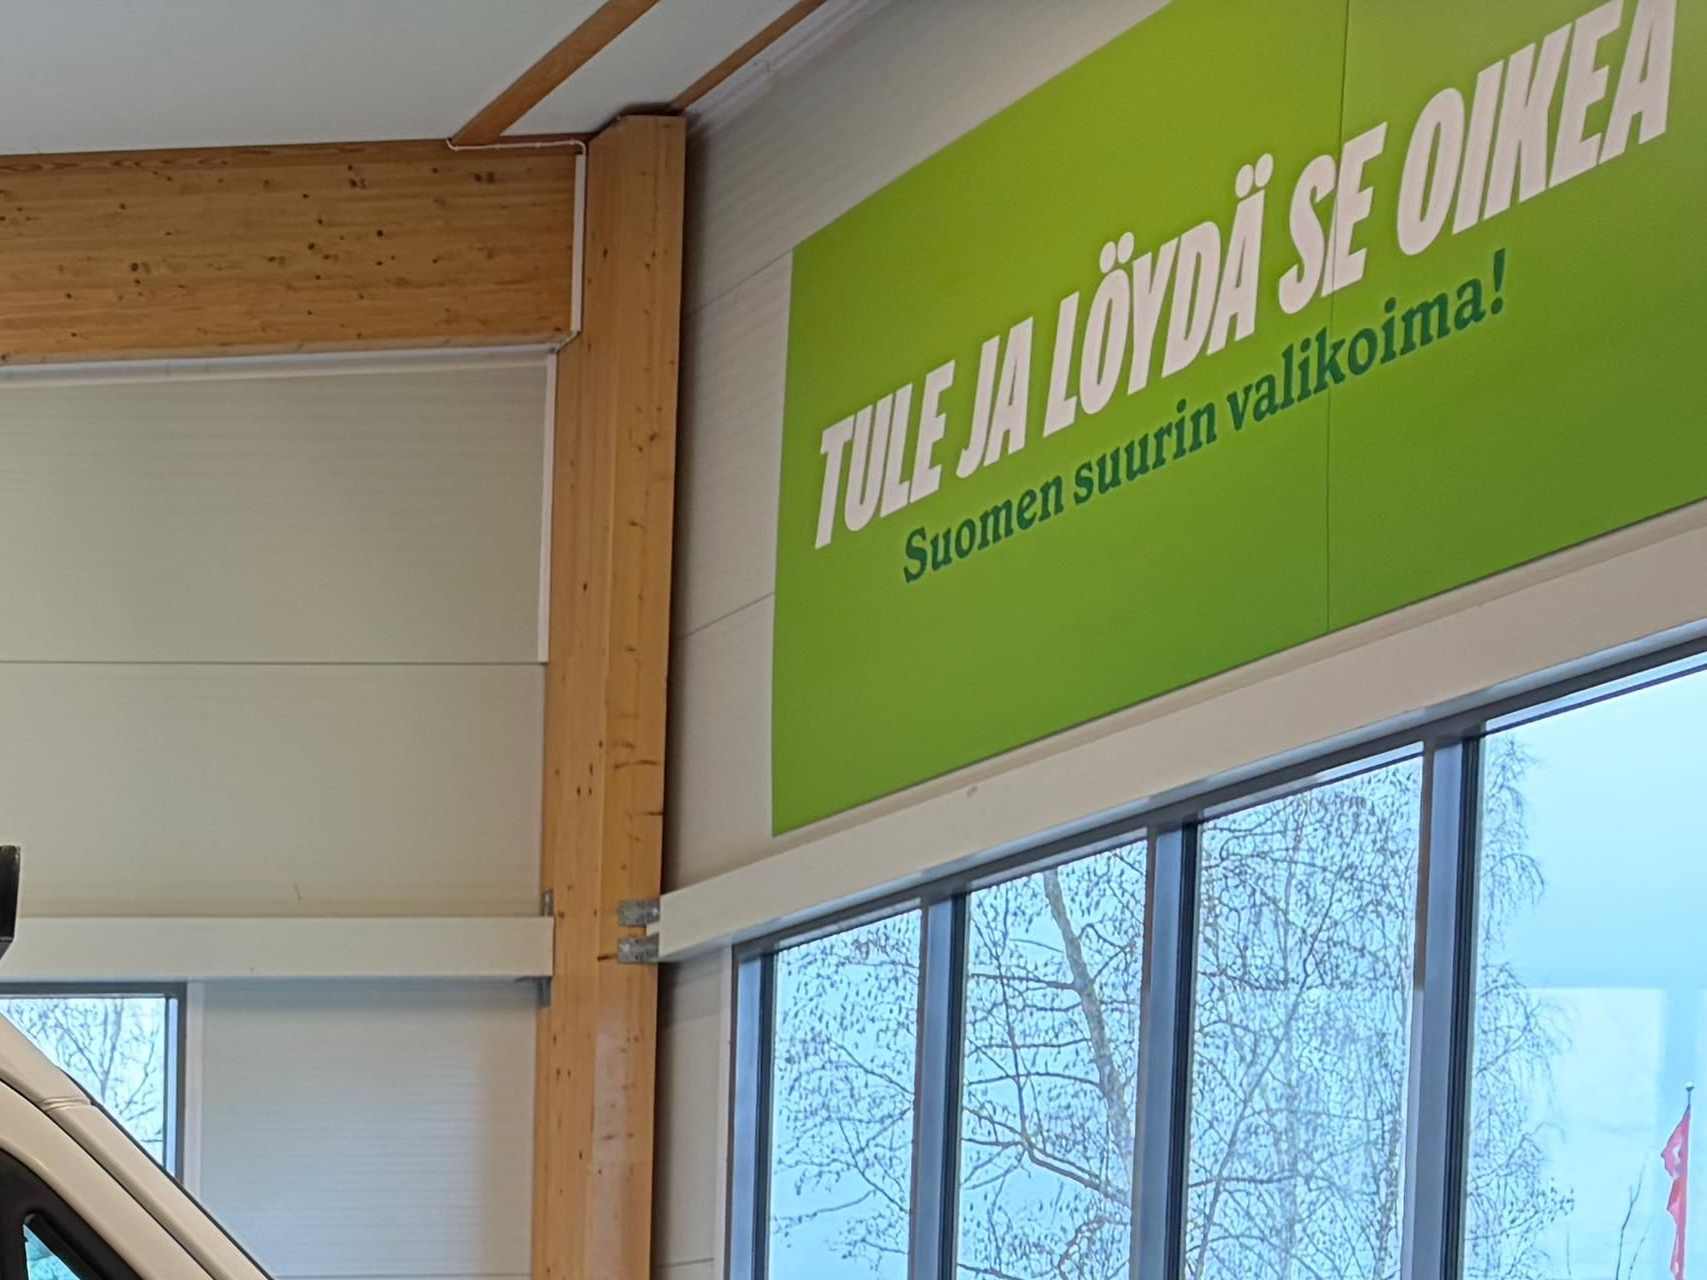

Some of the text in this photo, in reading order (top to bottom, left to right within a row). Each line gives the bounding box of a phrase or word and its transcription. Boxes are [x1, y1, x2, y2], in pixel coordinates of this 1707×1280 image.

[815, 0, 1676, 549] TULE JA LÖYDÄ SE OIKEA
[903, 248, 1507, 583] Suomen suurin valikoima!
